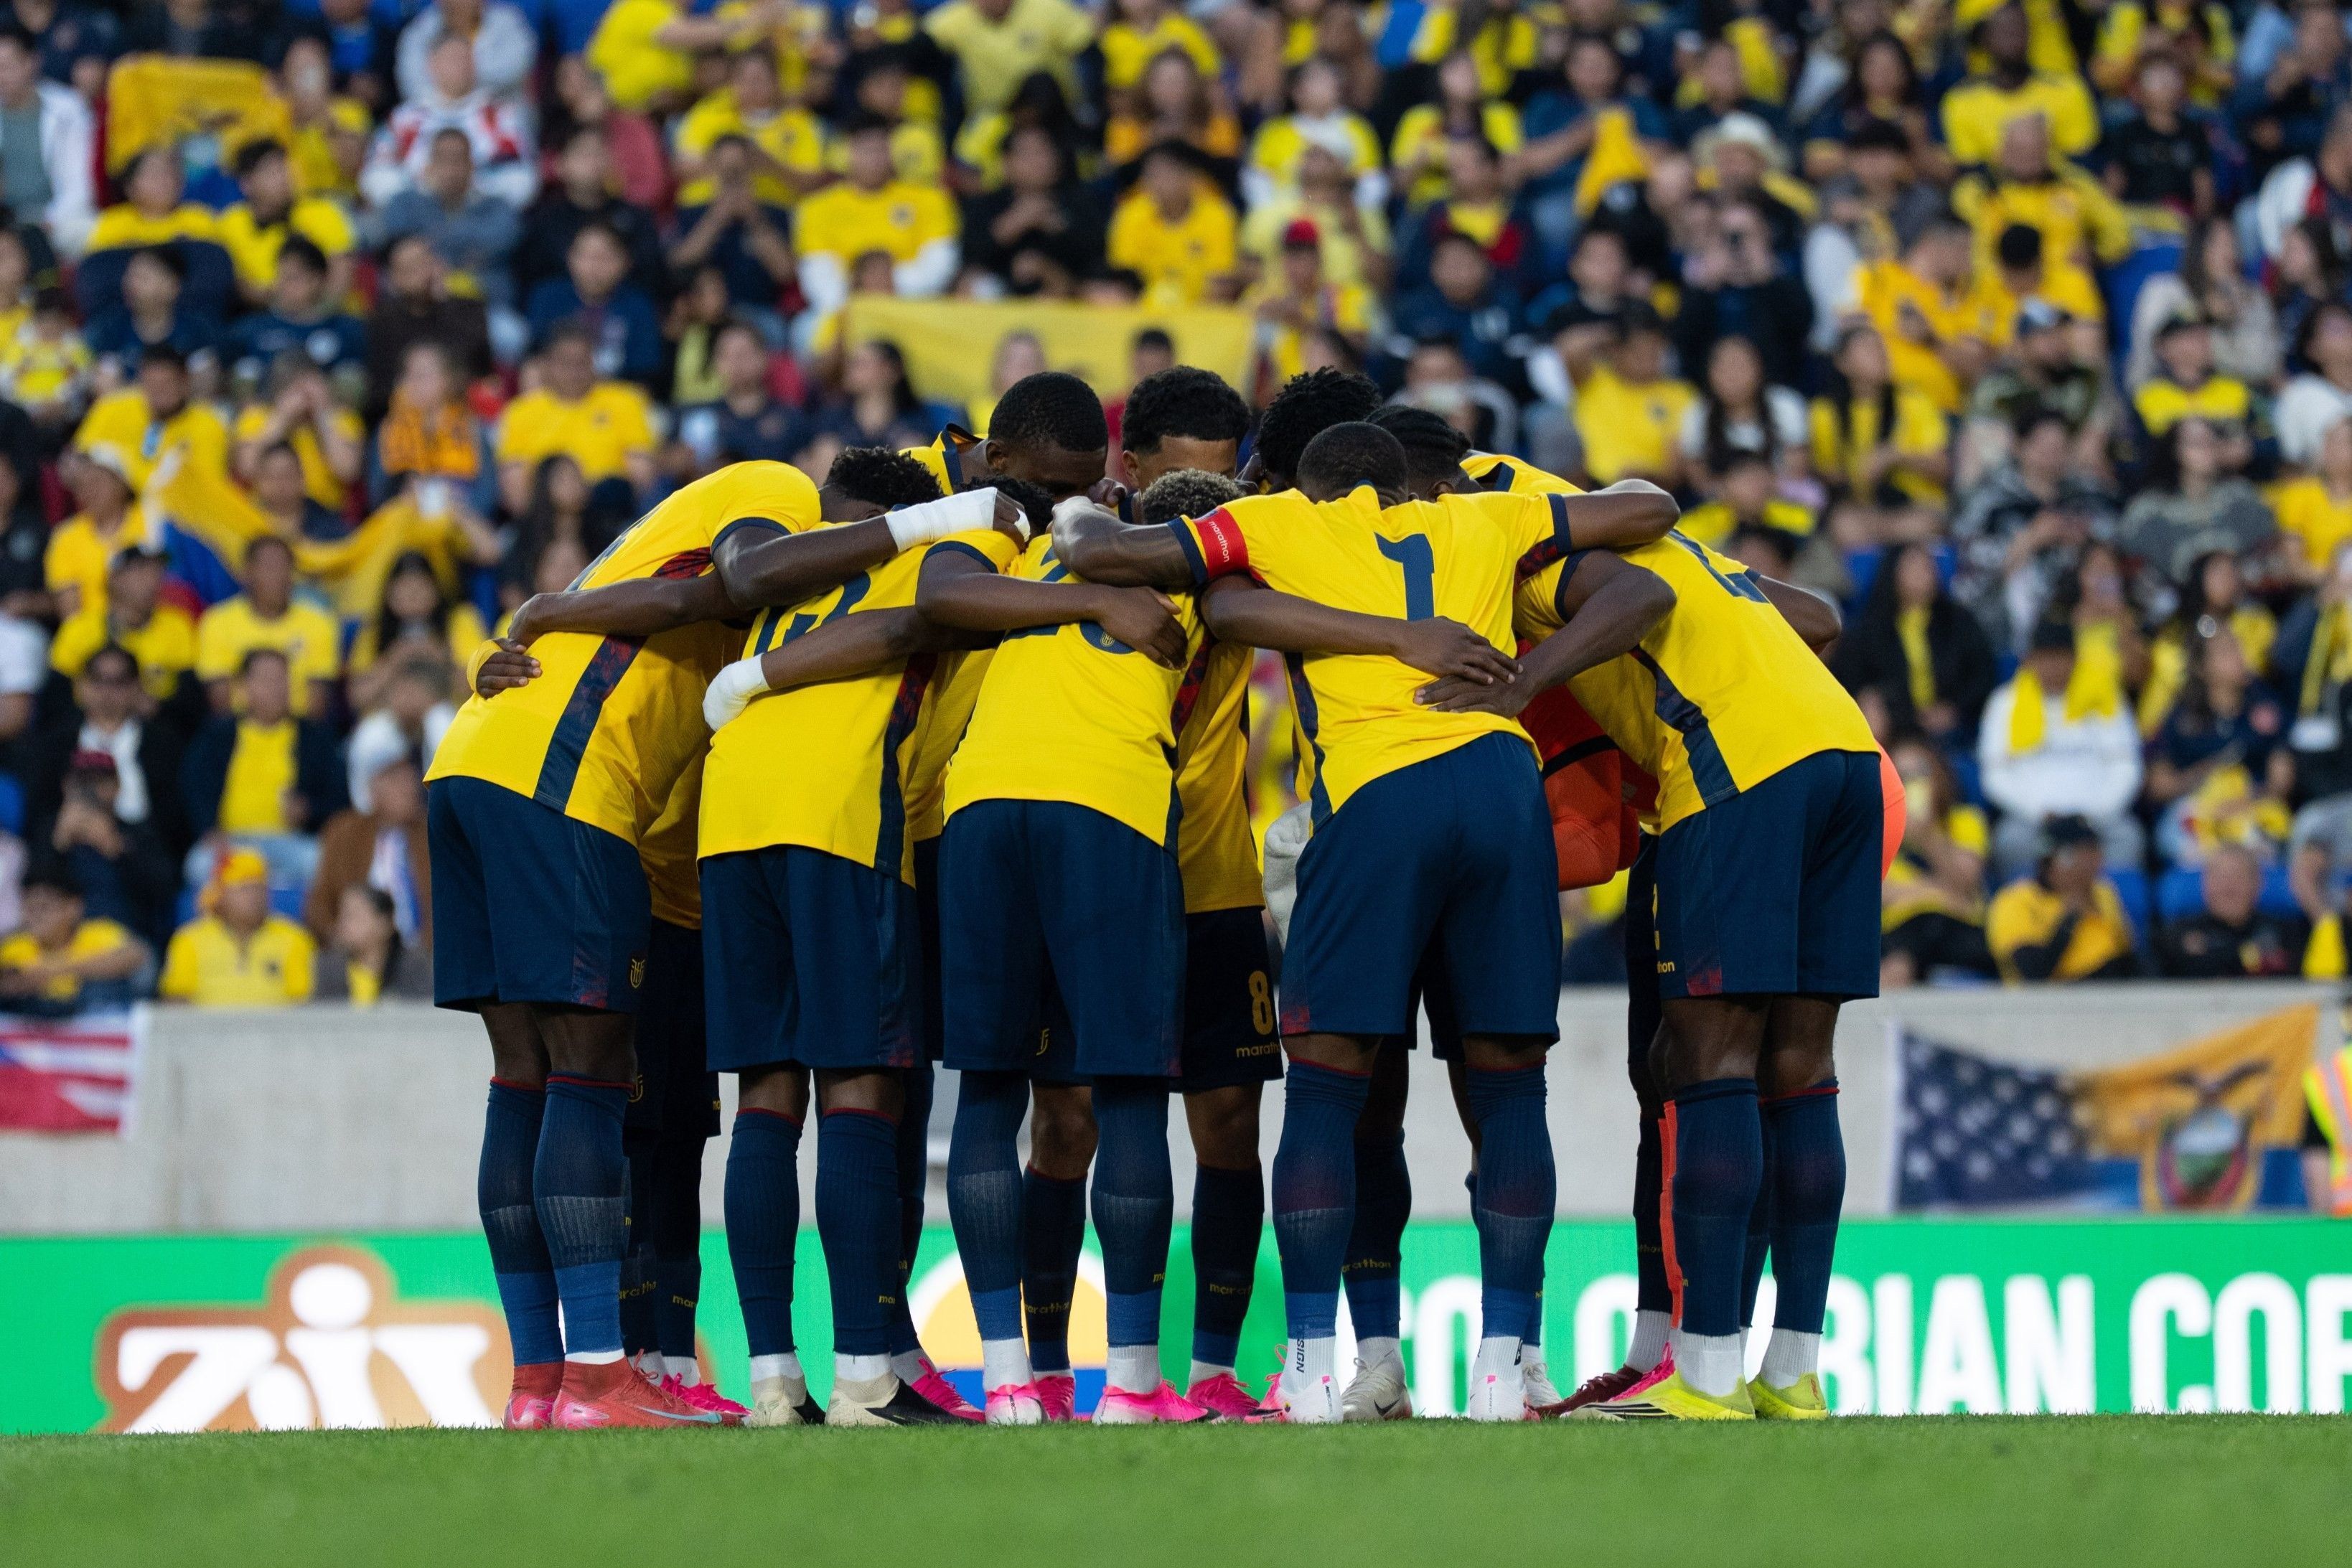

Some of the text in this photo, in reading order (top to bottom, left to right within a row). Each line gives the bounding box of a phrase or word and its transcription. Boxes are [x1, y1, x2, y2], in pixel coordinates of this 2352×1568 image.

[1208, 521, 1229, 563] marathon
[1374, 532, 1435, 621] 1
[1248, 970, 1274, 1036] 8
